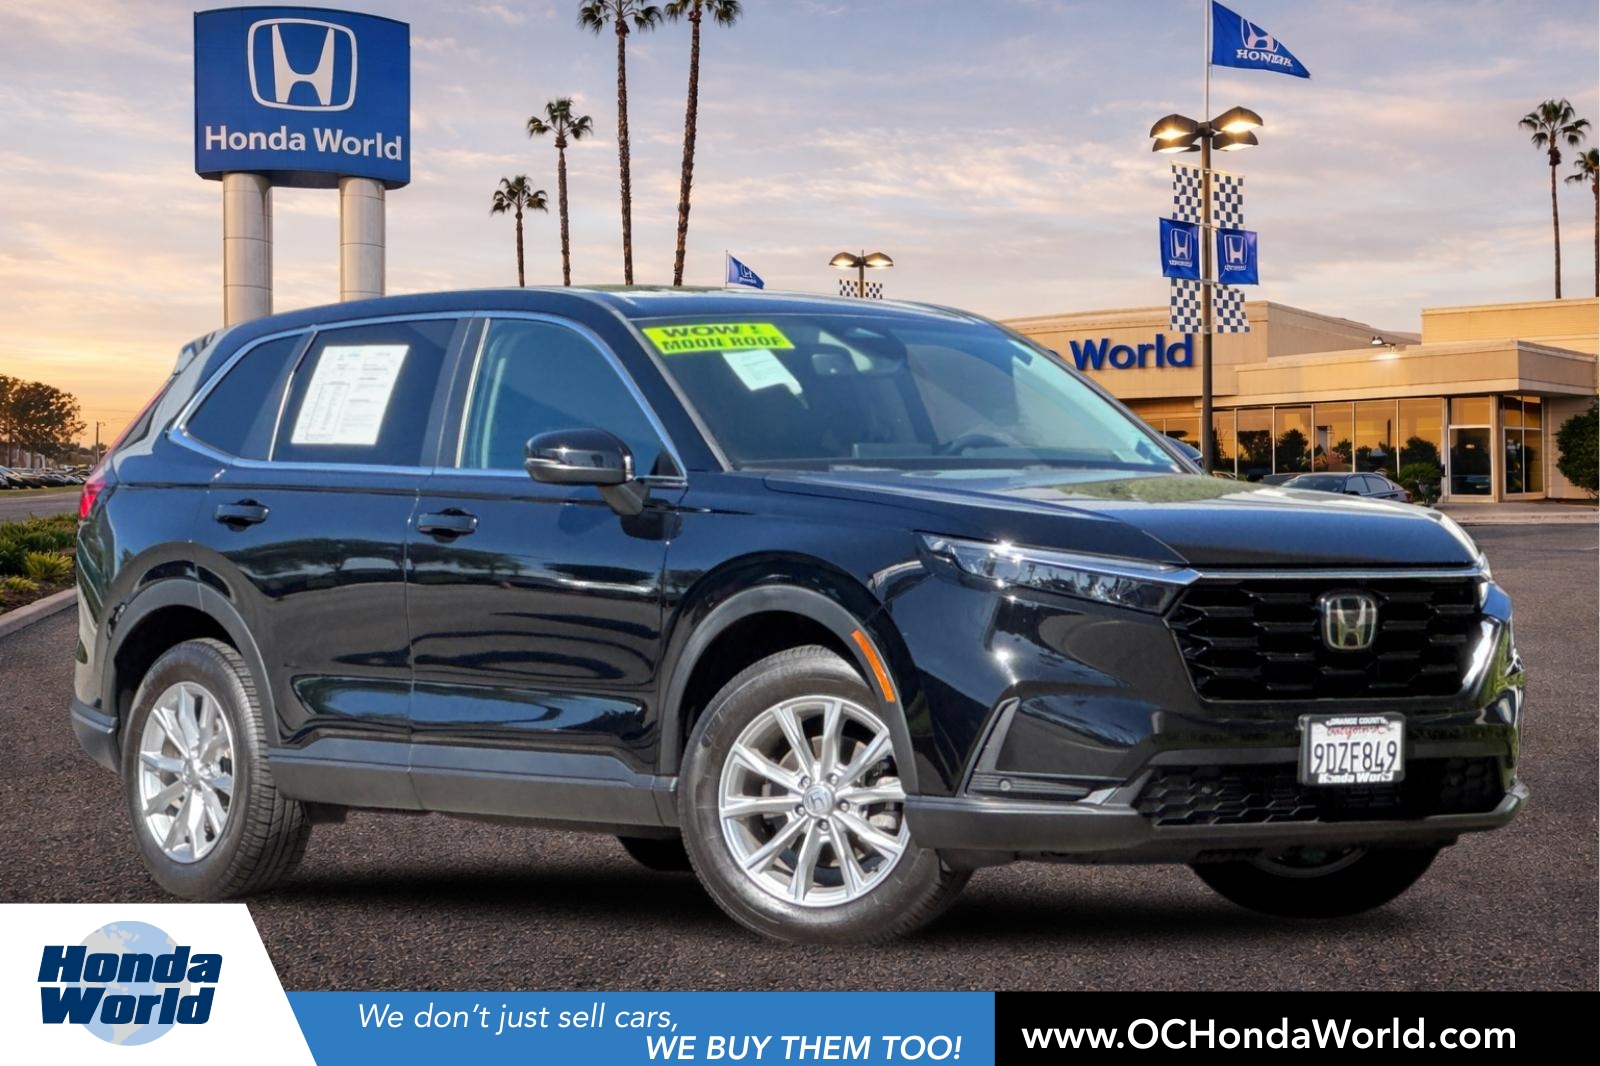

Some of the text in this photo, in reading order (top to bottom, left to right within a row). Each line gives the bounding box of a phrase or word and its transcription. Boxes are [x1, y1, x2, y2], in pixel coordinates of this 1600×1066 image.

[205, 125, 402, 161] Honda World
[661, 325, 740, 338] WOW
[661, 336, 782, 351] MOON ROOF
[1070, 333, 1194, 371] World
[1313, 741, 1398, 775] 9DZF849
